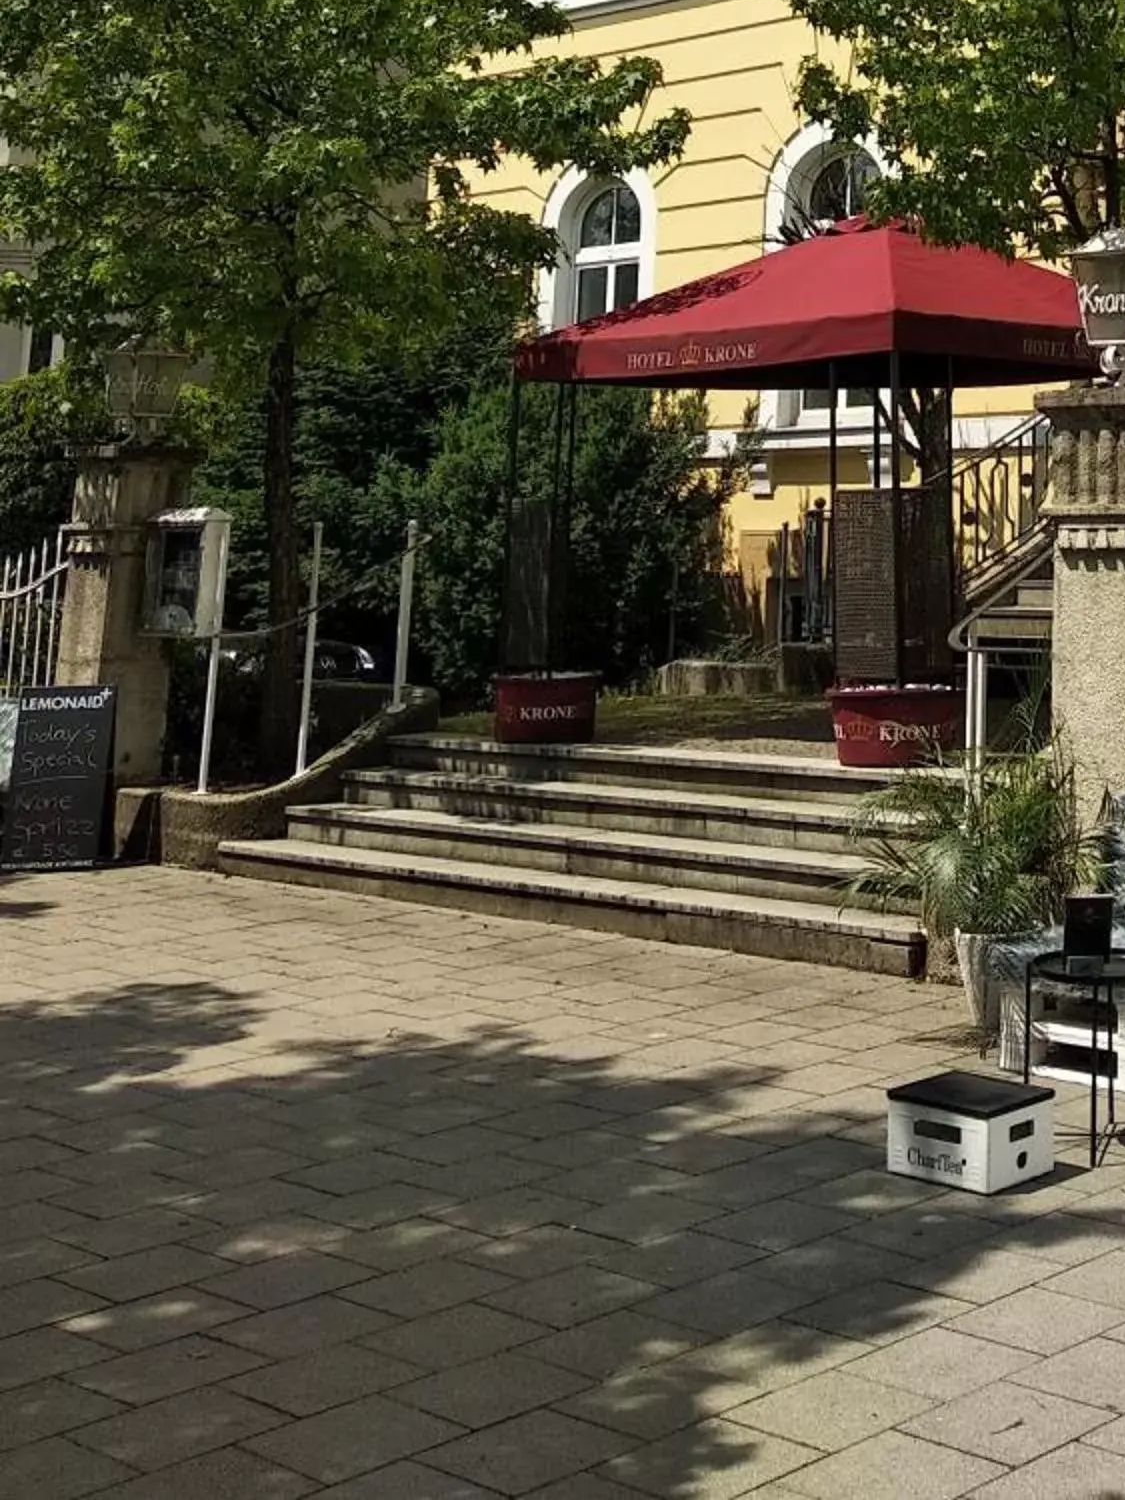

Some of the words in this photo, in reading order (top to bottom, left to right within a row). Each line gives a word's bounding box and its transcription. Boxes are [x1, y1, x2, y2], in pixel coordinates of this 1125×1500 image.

[627, 351, 674, 370] HOTEL
[704, 342, 758, 363] KRONE
[520, 705, 577, 721] KRONE
[880, 723, 941, 741] KRONE
[907, 1147, 963, 1176] ChariTea
